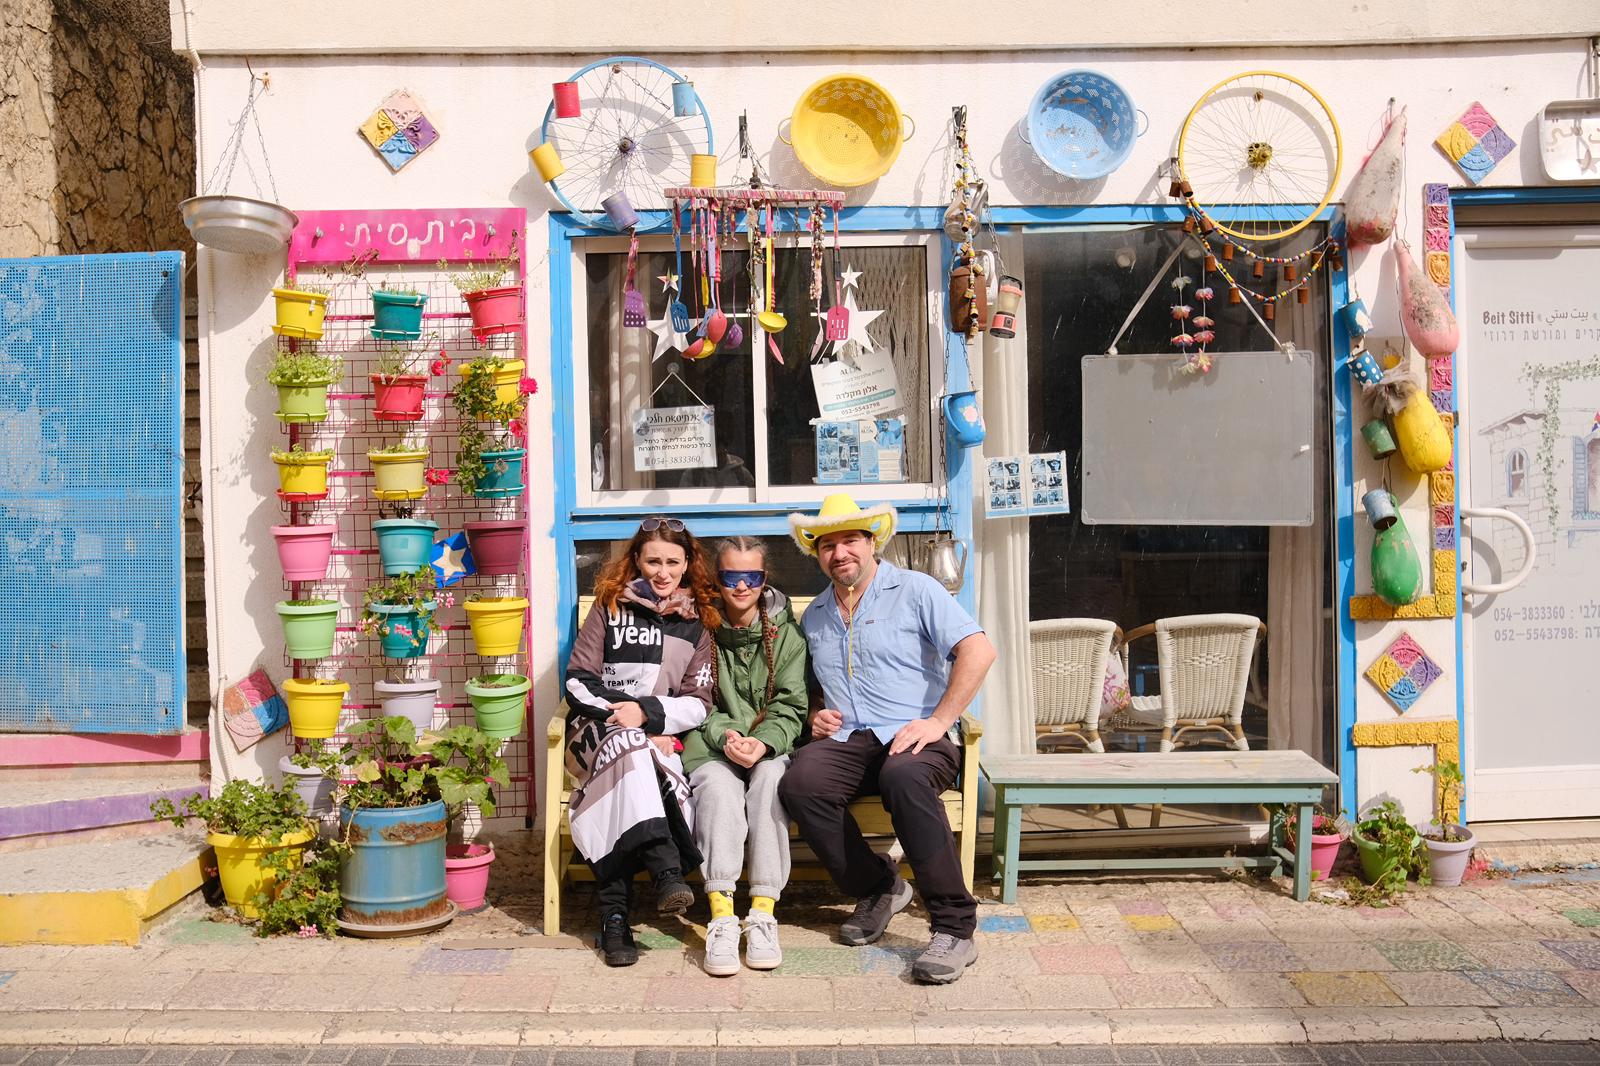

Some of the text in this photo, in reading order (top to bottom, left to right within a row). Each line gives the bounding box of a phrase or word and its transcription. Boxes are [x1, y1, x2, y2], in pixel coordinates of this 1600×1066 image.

[419, 218, 476, 245] בית
[1483, 310, 1534, 324] Beit Sitti
[1545, 308, 1589, 326] بيت ستي
[1523, 328, 1567, 341] ומורשת
[835, 389, 862, 400] מקלדה
[862, 384, 878, 396] אלון
[841, 401, 881, 415] 052-5543798
[651, 455, 701, 466] 054-3833360
[1494, 599, 1600, 621] 054-3833360 לבי
[612, 625, 662, 650] yeah
[607, 679, 625, 687] real
